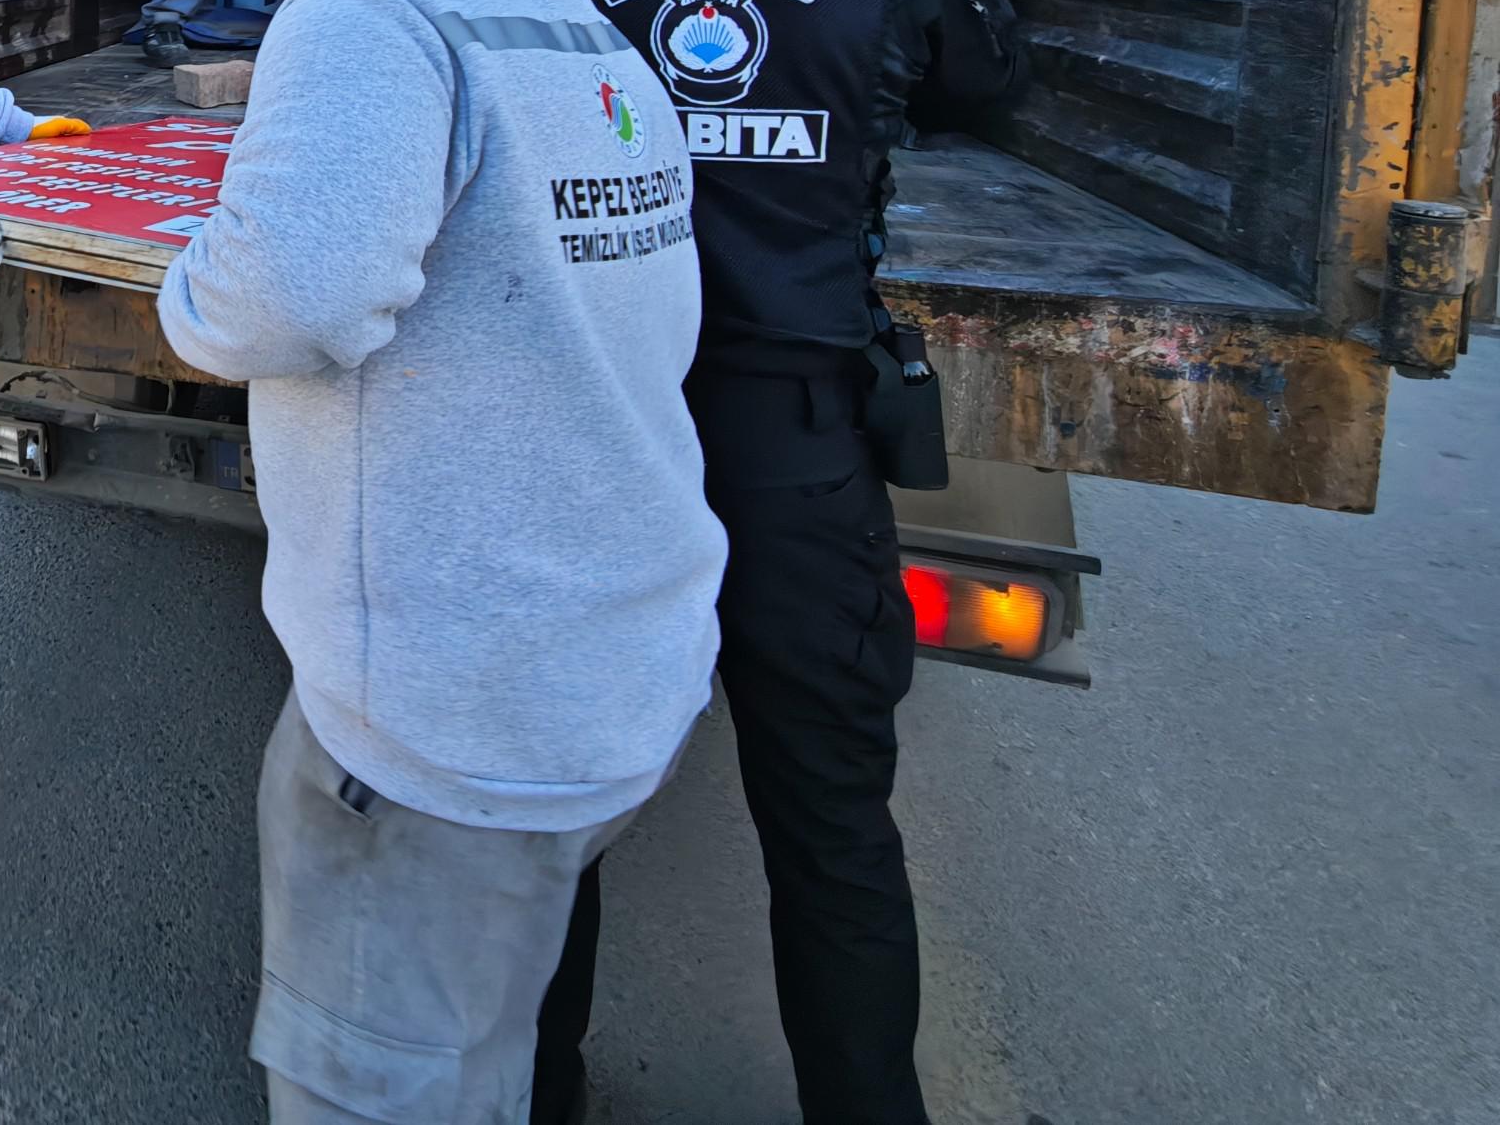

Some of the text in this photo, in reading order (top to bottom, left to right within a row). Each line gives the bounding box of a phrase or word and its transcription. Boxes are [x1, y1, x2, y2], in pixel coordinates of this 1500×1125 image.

[22, 143, 196, 167] LAHMACUN
[687, 113, 816, 157] BITA
[551, 177, 628, 220] KEPEZ
[560, 225, 631, 264] TEMİZLİK
